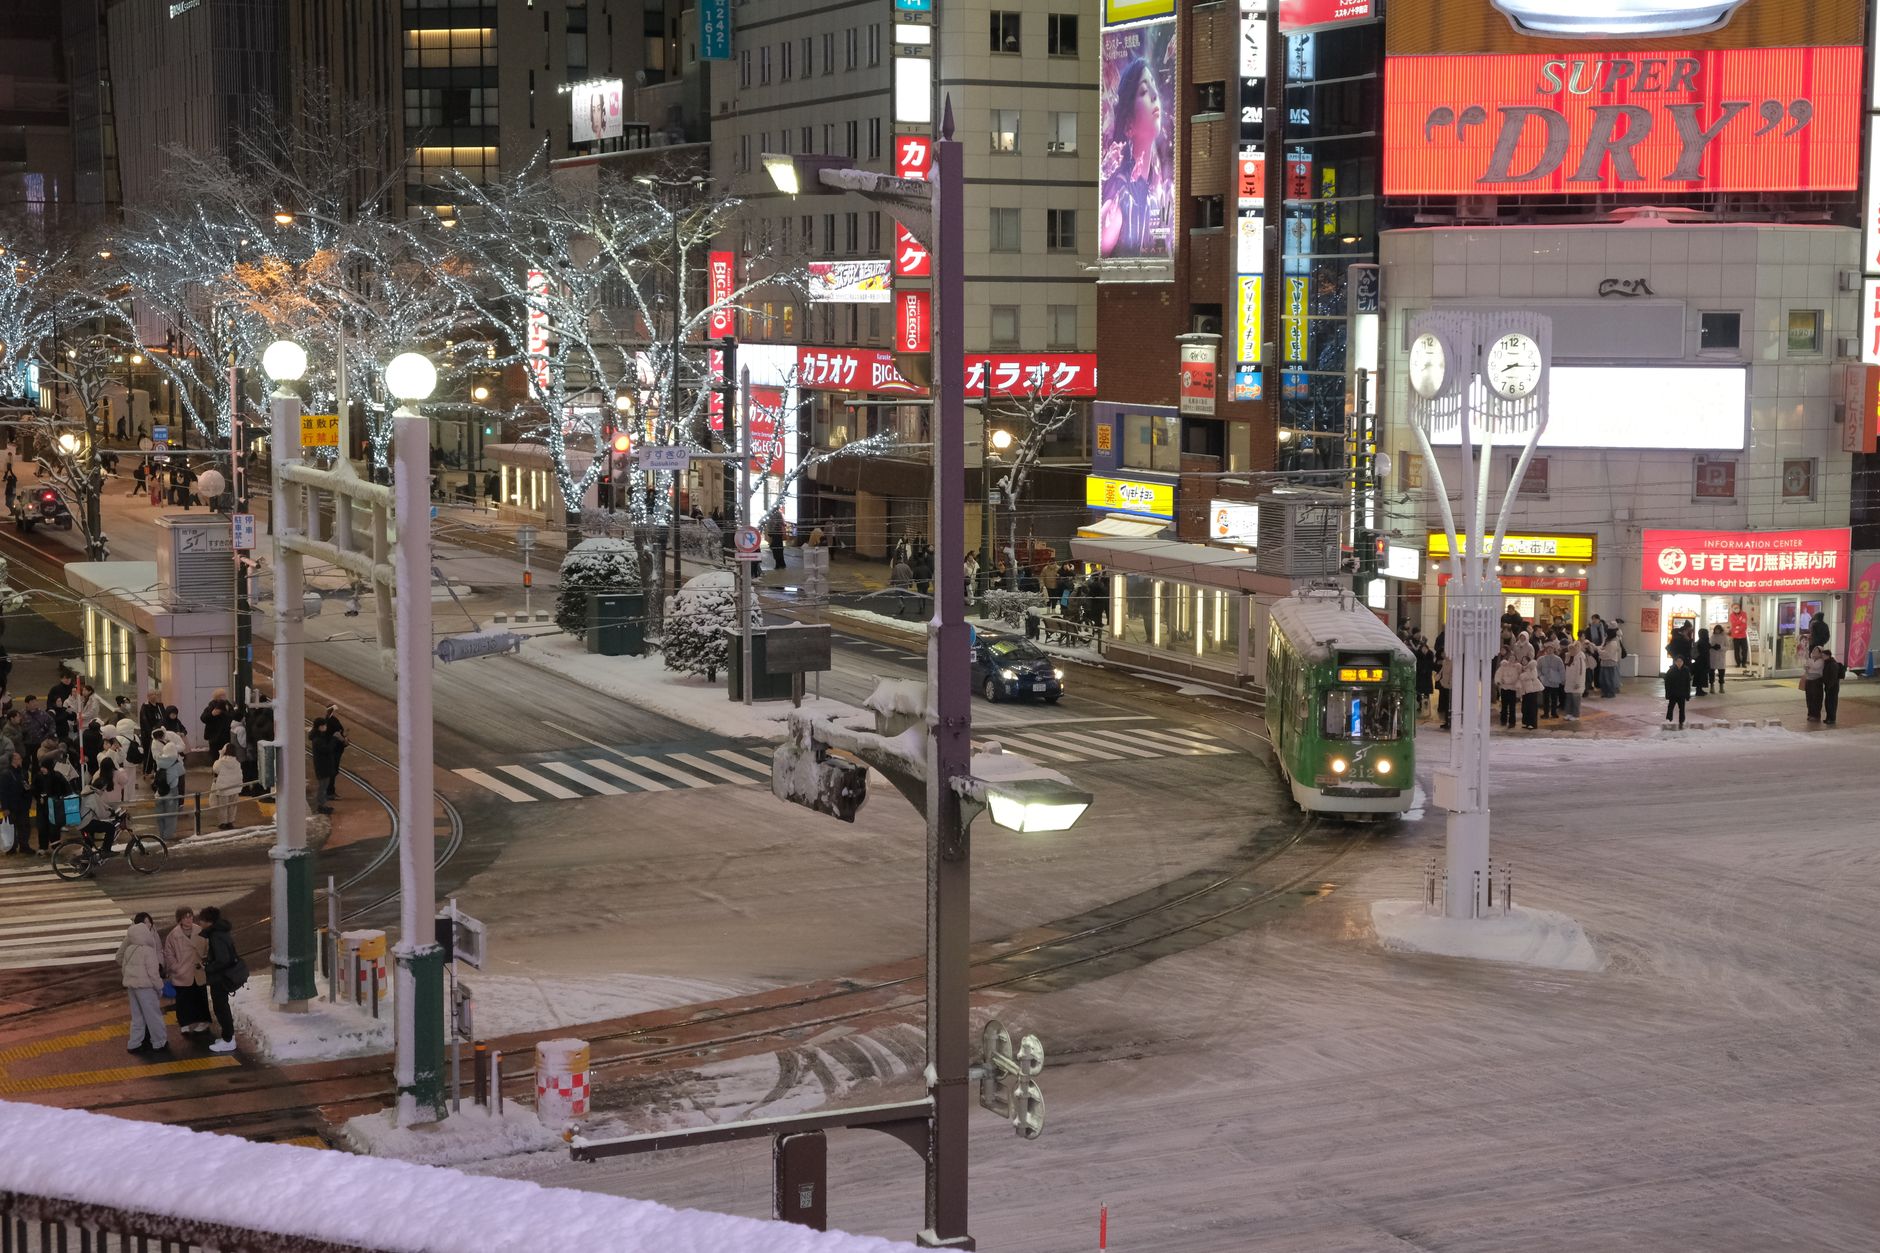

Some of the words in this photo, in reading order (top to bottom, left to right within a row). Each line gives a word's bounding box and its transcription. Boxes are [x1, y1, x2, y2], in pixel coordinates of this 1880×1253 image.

[705, 10, 713, 56] 1611
[1247, 79, 1258, 87] 4F
[1536, 57, 1701, 95] SUPER
[1242, 106, 1263, 123] 2M
[901, 141, 926, 272] カケ
[714, 261, 727, 288] BIG
[907, 295, 917, 316] BIG
[1244, 279, 1255, 358] マツモトキヨシ
[907, 317, 917, 349] ECHO
[1509, 337, 1519, 347] 12
[1501, 342, 1508, 351] 11
[1522, 342, 1526, 350] 1
[803, 353, 858, 384] カラオケ
[872, 362, 892, 386] BIG
[965, 362, 1080, 390] カラオケ
[1501, 382, 1507, 391] 7
[1509, 384, 1516, 394] 6
[1519, 382, 1525, 391] 5
[1099, 427, 1110, 448] 薬
[645, 449, 686, 459] すすきの
[234, 515, 242, 548] 駐車禁止
[1704, 540, 1770, 549] INFORMATION
[1773, 539, 1803, 548] CENTER
[1689, 550, 1837, 572] すすきの無料案内所
[1682, 577, 1699, 586] find
[1701, 578, 1716, 586] the
[1717, 578, 1737, 588] right
[1739, 578, 1757, 587] bars
[1758, 578, 1772, 587] and
[1773, 577, 1810, 586] restaurants
[1811, 577, 1820, 585] for
[1821, 577, 1836, 586] you.
[1350, 765, 1374, 778] 212
